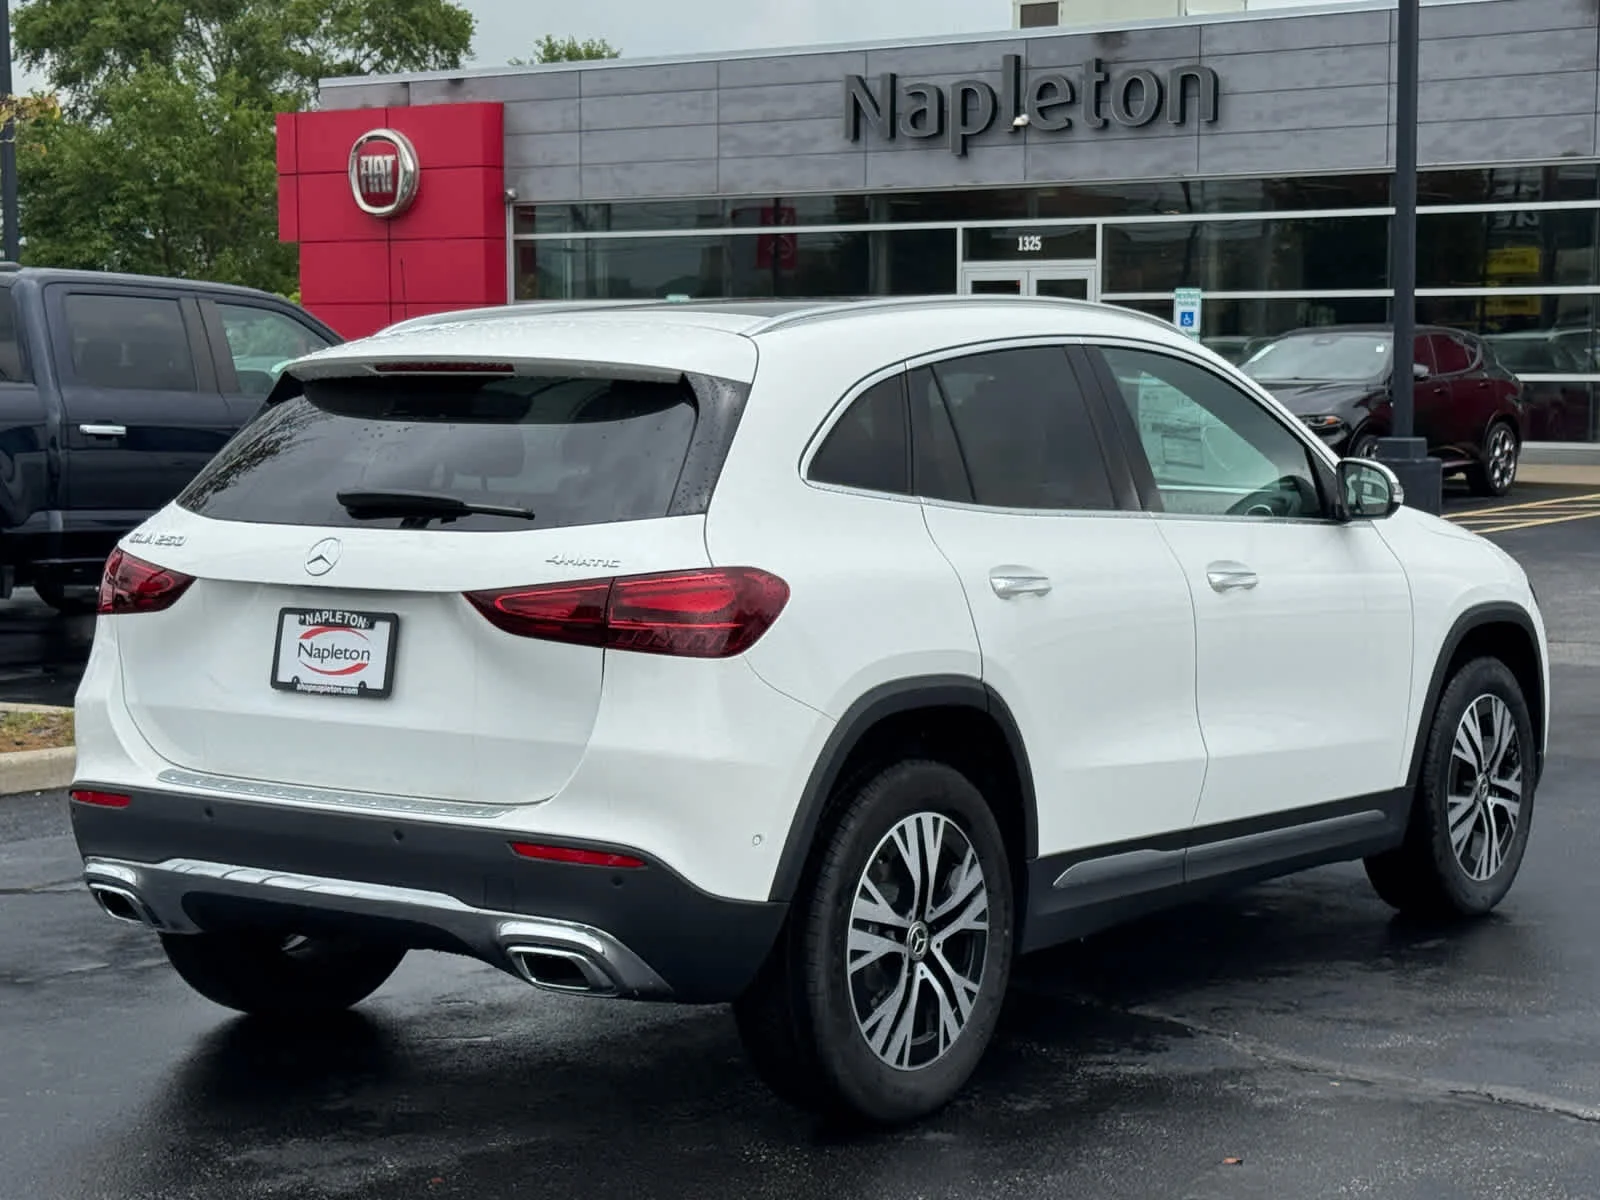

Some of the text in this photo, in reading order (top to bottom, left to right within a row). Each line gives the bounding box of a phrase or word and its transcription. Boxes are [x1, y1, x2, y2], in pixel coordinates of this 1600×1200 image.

[843, 54, 1219, 156] Napleton
[360, 155, 396, 193] FIAT
[1017, 235, 1042, 251] 1325
[129, 532, 185, 547] GLA 250
[545, 555, 621, 569] 4MATIC
[305, 611, 367, 629] NAPLETON
[298, 641, 371, 664] Napleton
